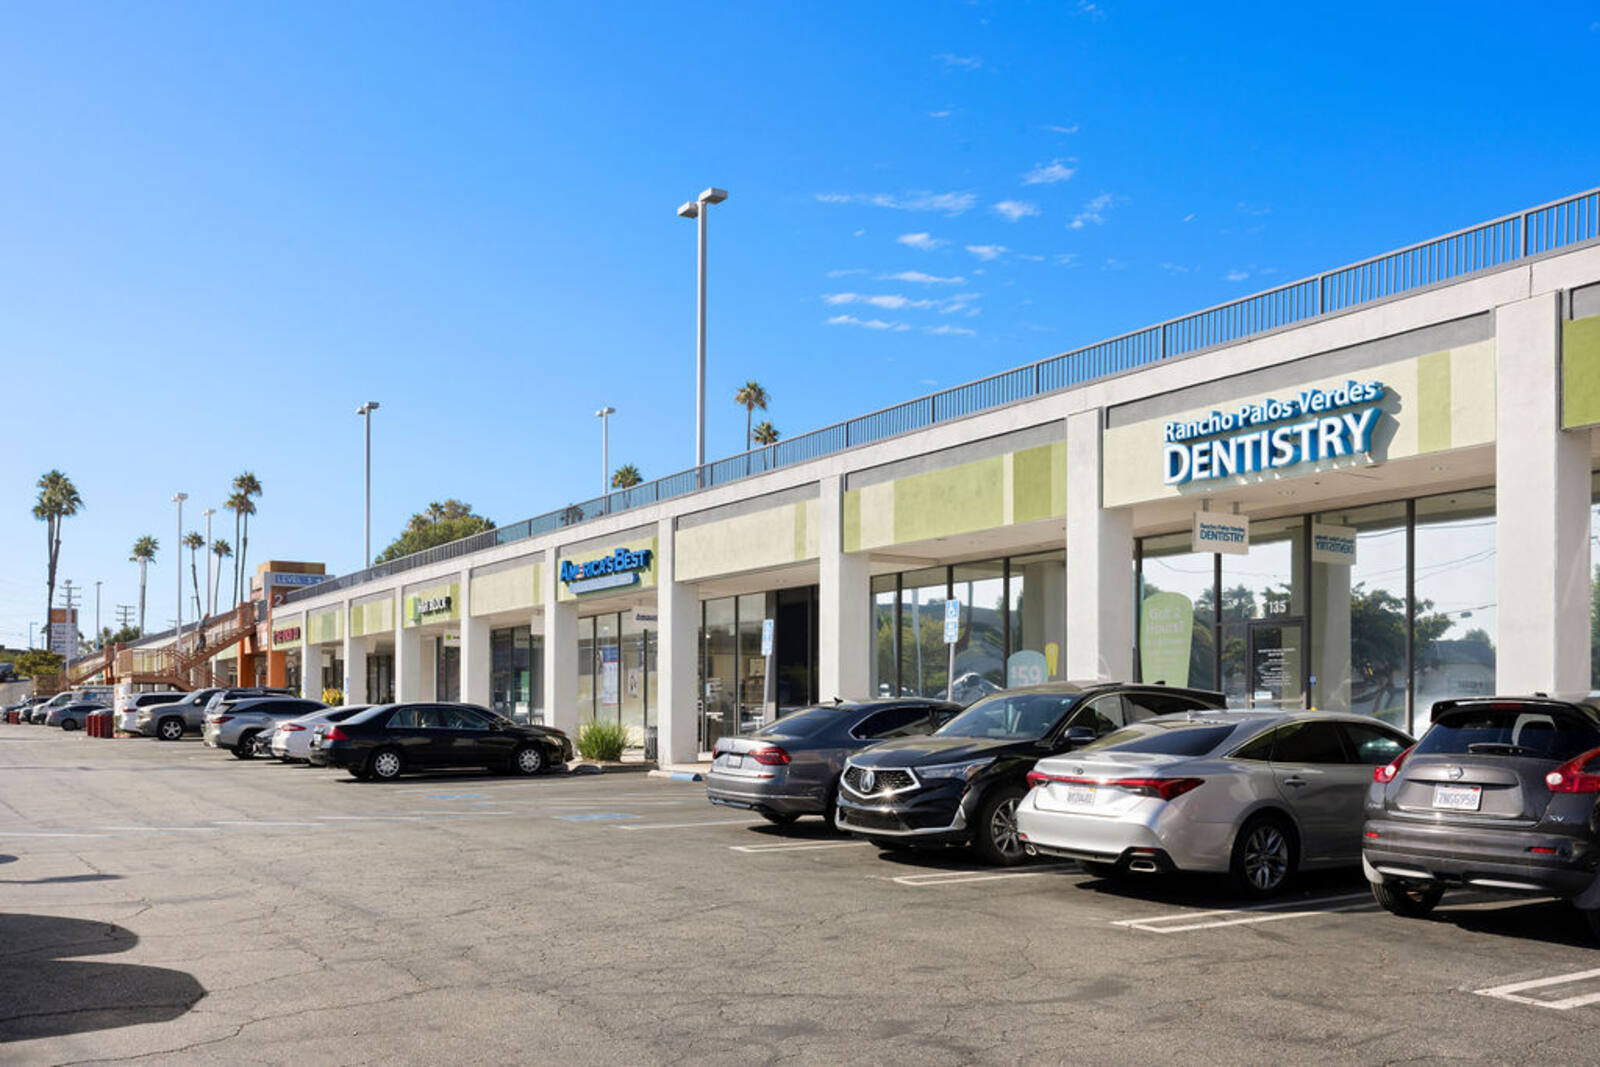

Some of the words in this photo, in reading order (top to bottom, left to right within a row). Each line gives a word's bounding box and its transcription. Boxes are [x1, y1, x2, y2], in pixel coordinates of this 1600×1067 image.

[1164, 410, 1237, 442] Rancho
[1238, 399, 1297, 427] Palos
[1299, 380, 1381, 415] Verdes
[1163, 406, 1380, 486] DENTISTRY
[1200, 529, 1245, 544] DENTISTRY
[1269, 600, 1287, 614] 135
